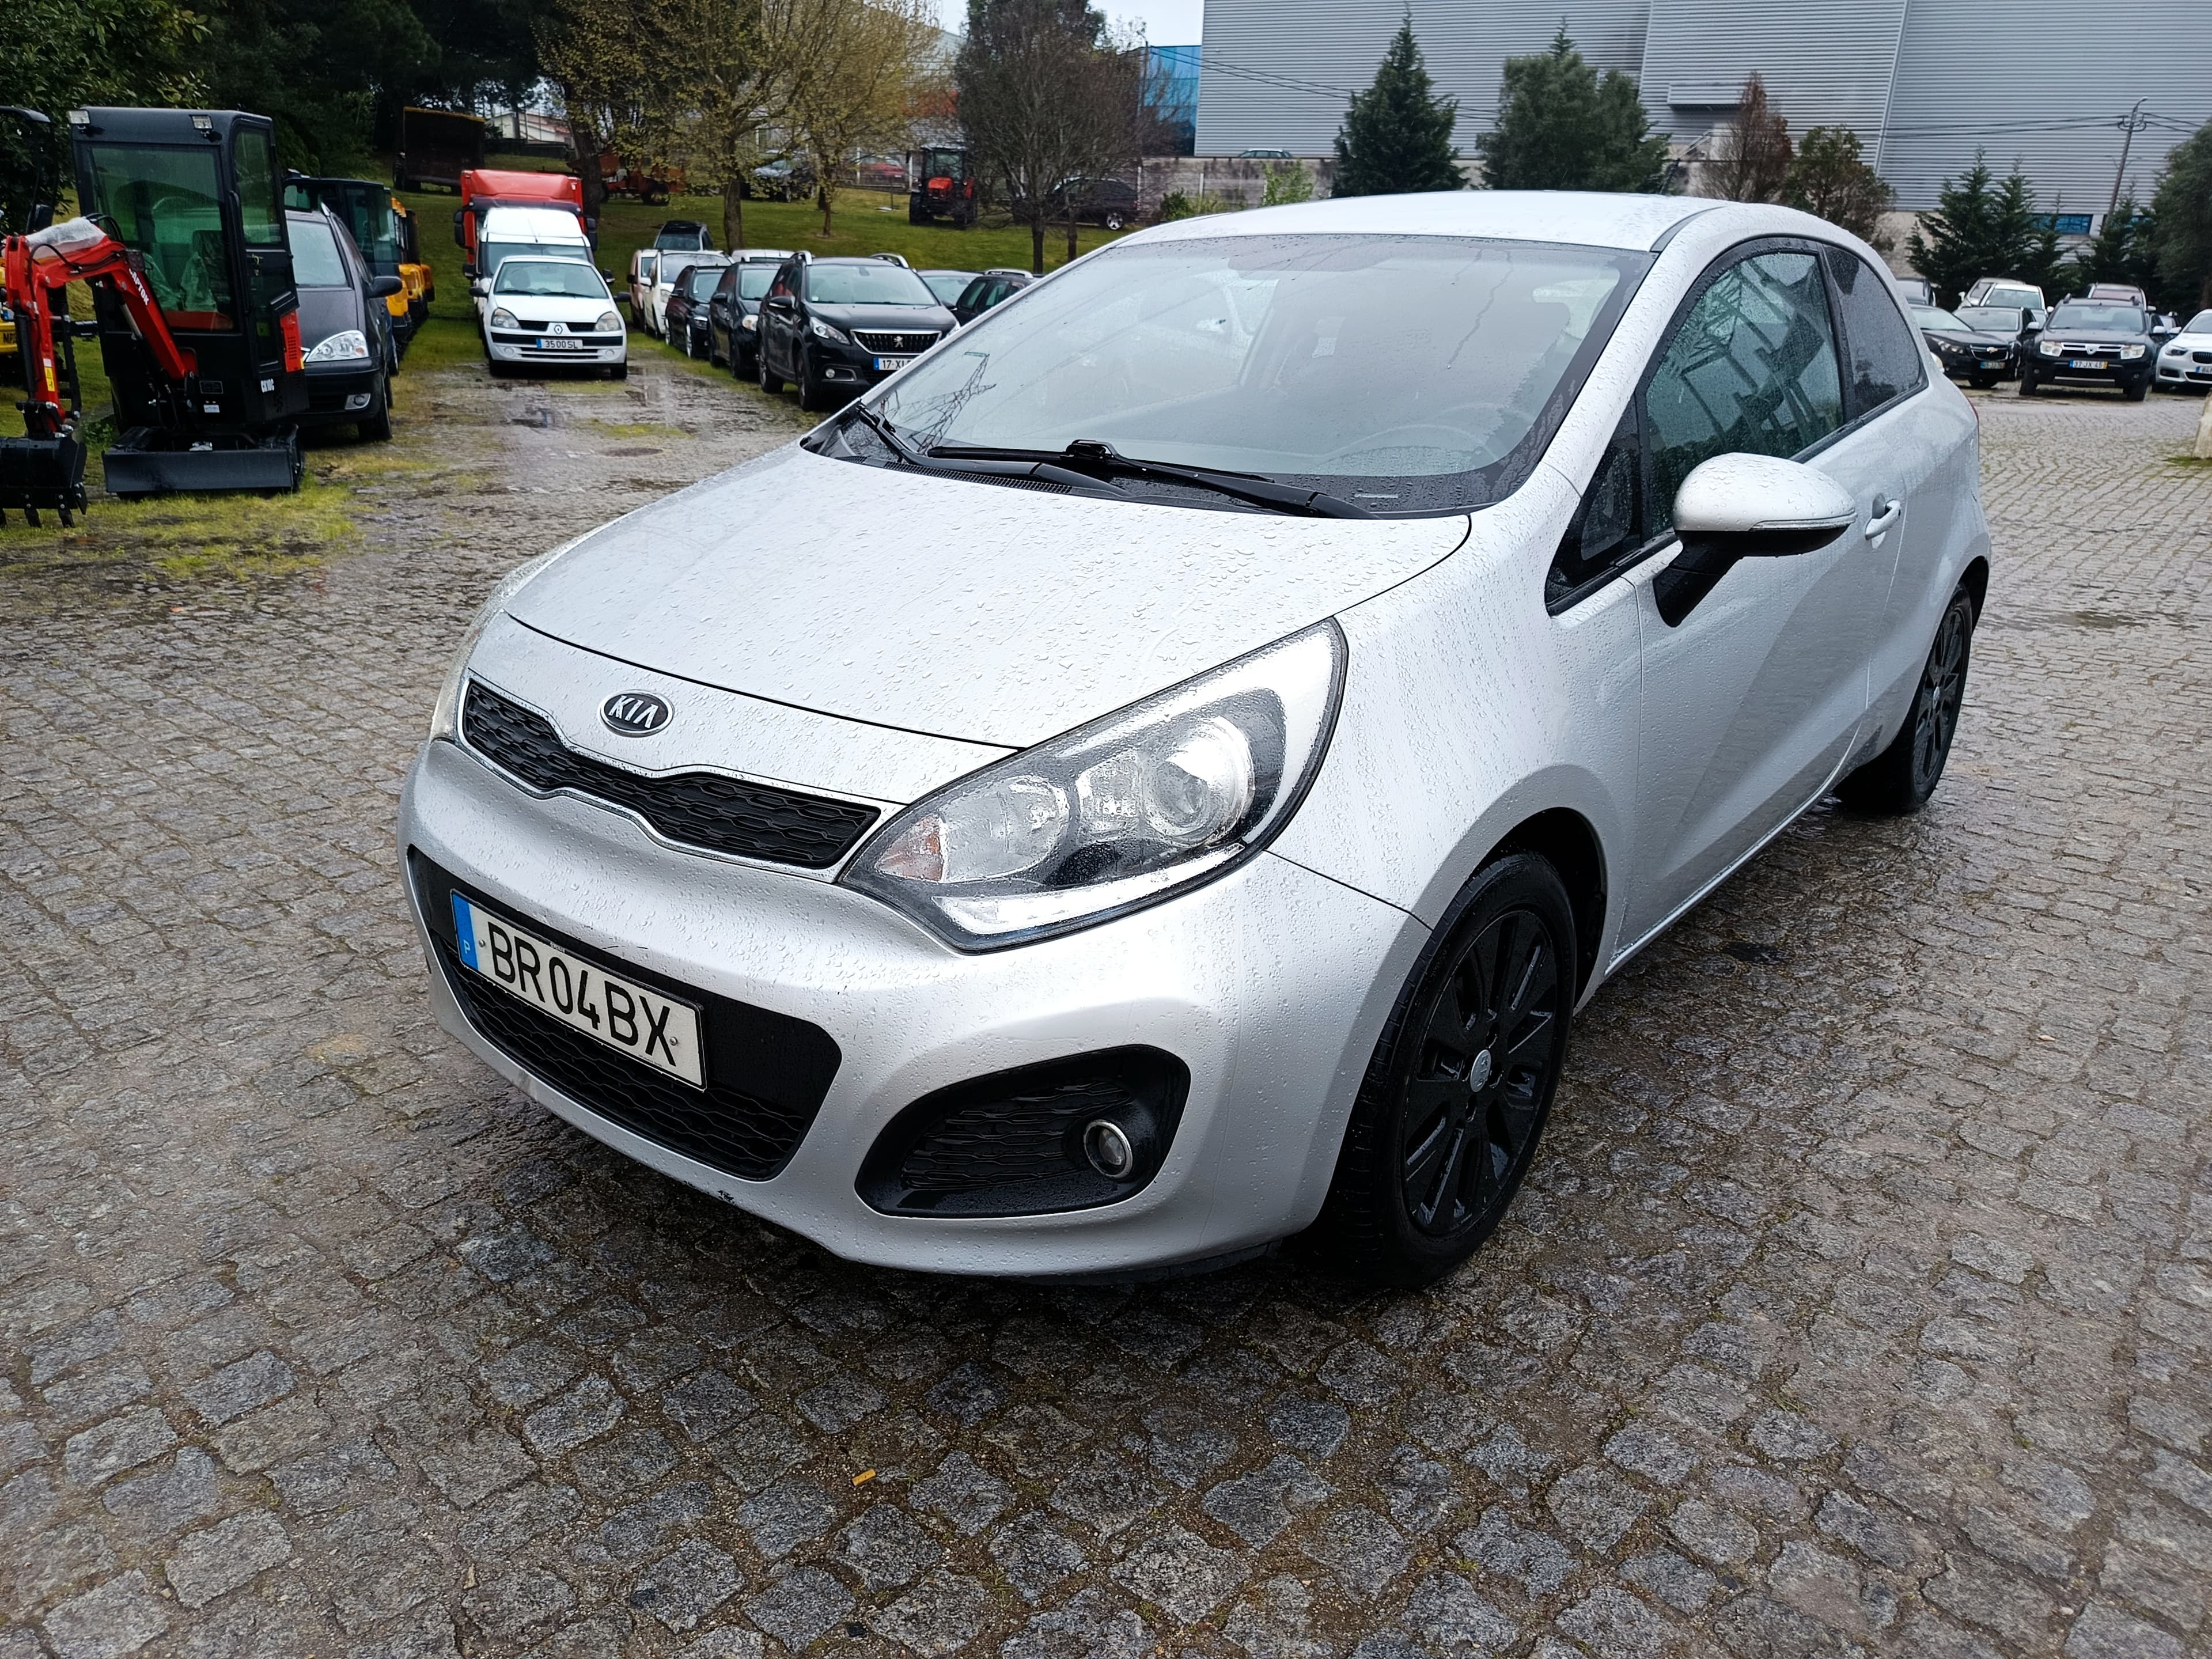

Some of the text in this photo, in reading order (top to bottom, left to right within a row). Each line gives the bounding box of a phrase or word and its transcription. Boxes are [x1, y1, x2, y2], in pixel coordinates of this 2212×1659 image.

[608, 695, 659, 729] KIA
[463, 939, 471, 955] P
[488, 922, 677, 1067] BR04BX
